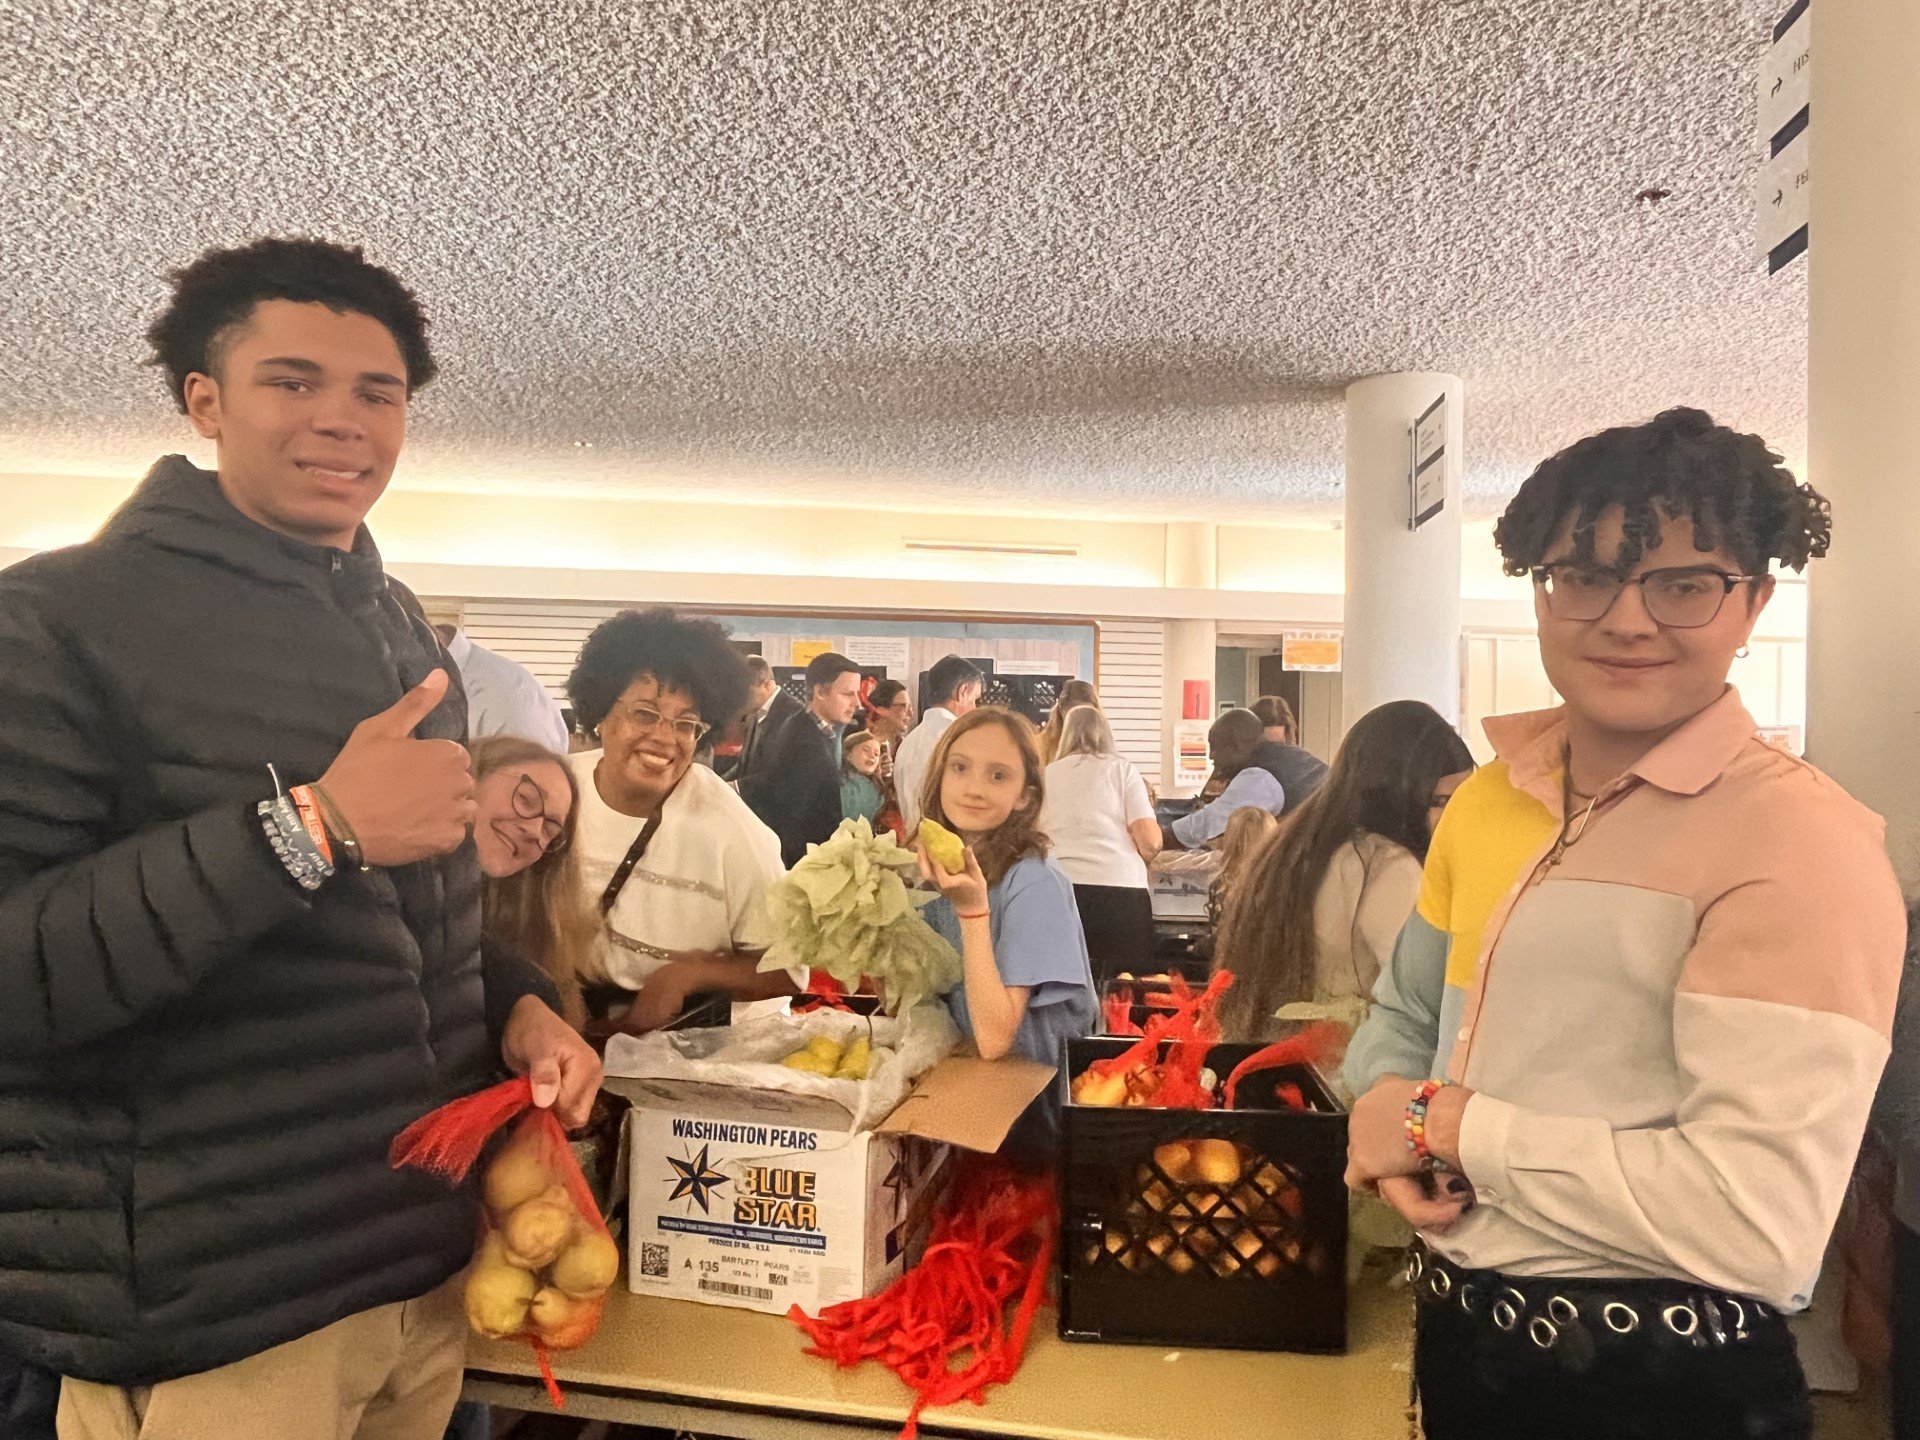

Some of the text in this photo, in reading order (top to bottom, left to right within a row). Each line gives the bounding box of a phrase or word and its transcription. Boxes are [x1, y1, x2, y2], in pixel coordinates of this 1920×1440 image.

[672, 1118, 819, 1151] WASHINGTON PEARS
[733, 1196, 817, 1232] STAR
[684, 1257, 693, 1269] A
